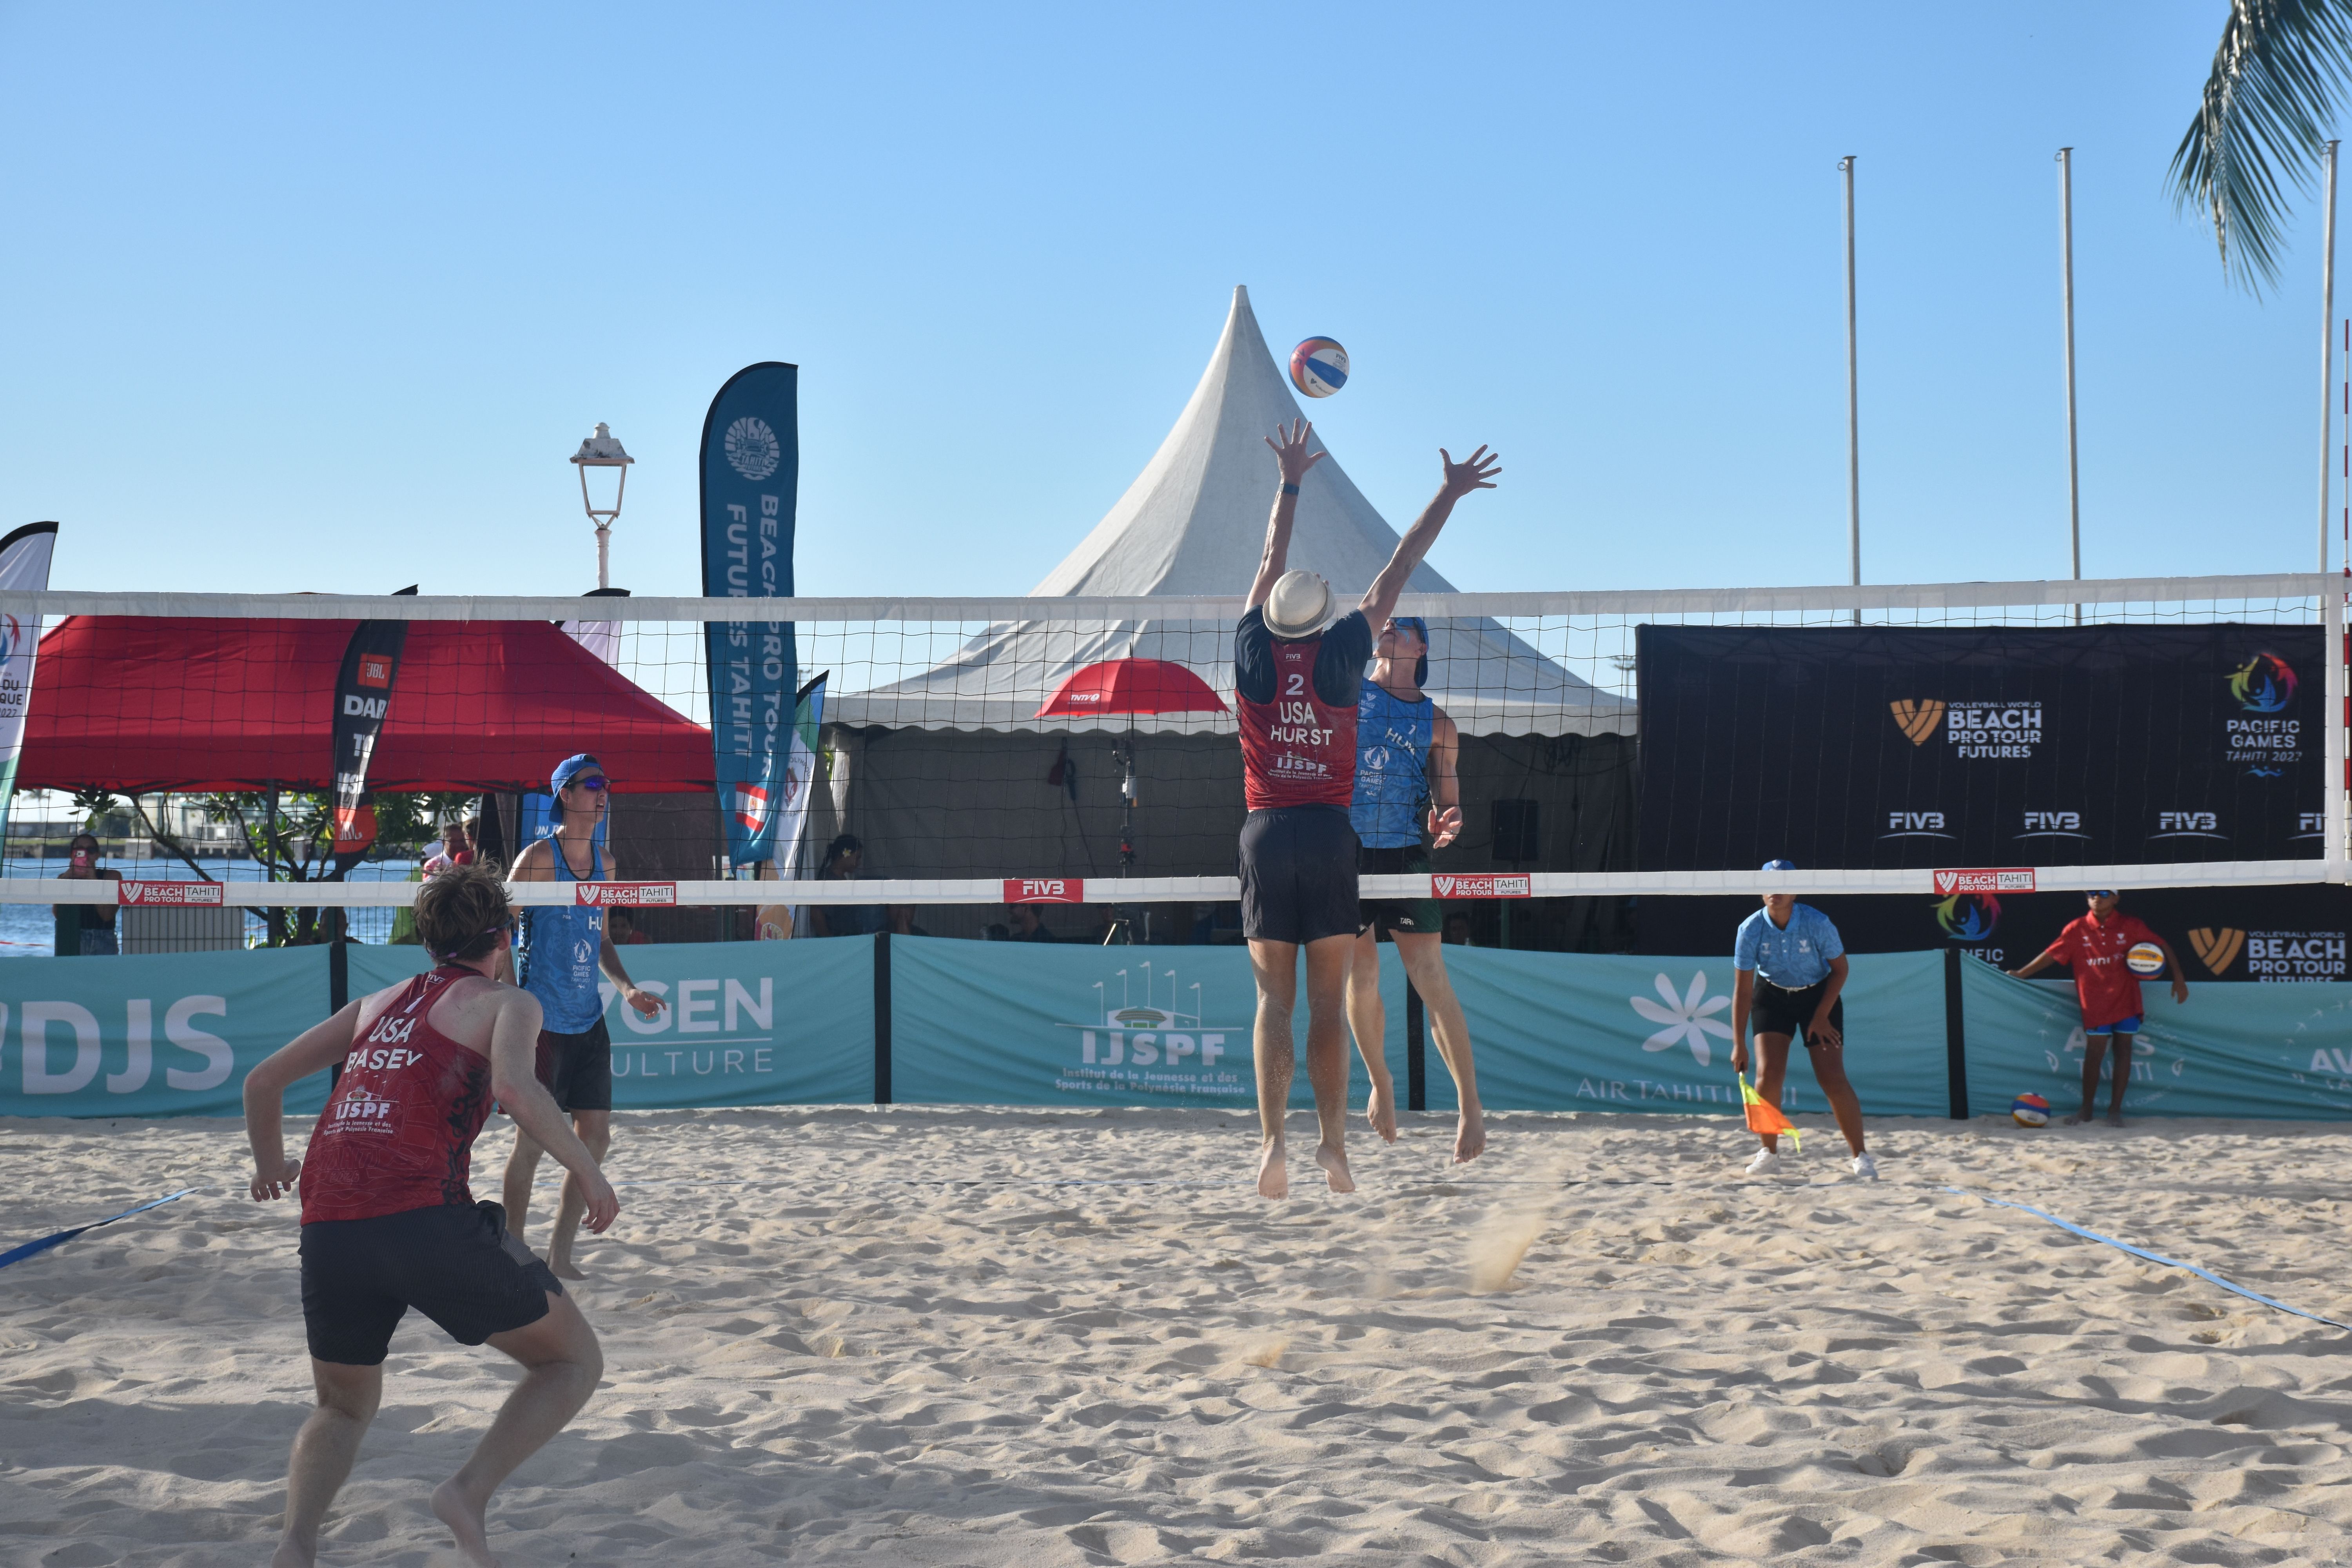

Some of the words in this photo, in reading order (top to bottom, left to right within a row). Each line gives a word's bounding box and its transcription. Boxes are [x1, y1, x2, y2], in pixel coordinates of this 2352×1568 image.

[760, 494, 779, 597] BEACH
[367, 662, 385, 679] JBL
[3, 679, 19, 691] DU
[1286, 674, 1304, 695] 2
[0, 708, 17, 717] 027
[344, 695, 390, 719] DAR
[731, 657, 752, 757] TAHITI
[1280, 702, 1316, 724] USA
[1948, 709, 2042, 729] BEACH
[2227, 720, 2300, 733] PACIFIC
[1270, 725, 1333, 745] HURST
[1948, 731, 1987, 744] PRO
[1990, 730, 2042, 744] TOUR
[2231, 735, 2296, 748] GAMES
[1958, 746, 2031, 758] FUTURES
[2226, 751, 2266, 761] TAHITI
[1277, 757, 1327, 773] IJSPF
[1360, 770, 1387, 780] PACIFIC
[1361, 776, 1384, 785] GAMES
[1889, 812, 1944, 829] FIVB
[2025, 812, 2080, 829] FIVB
[2160, 812, 2217, 830] FIVB
[2299, 813, 2325, 830] FI
[1456, 881, 1492, 890] BEACH
[1495, 879, 1527, 888] TAHITI
[1958, 876, 1996, 885] BEACH
[1999, 874, 2031, 882] TAHITI
[144, 887, 183, 897] BEACH
[186, 887, 220, 896] TAHITI
[601, 889, 637, 898] BEACH
[640, 887, 673, 897] TAHITI
[1023, 881, 1064, 895] FIVB
[589, 916, 603, 931] HU
[2248, 939, 2346, 959] BEACH
[2249, 960, 2290, 974] PRO
[2292, 960, 2346, 975] TOUR
[368, 1016, 416, 1043] USA
[1083, 1030, 1225, 1066] IJSPF
[2064, 1026, 2155, 1056] AS
[611, 1048, 773, 1077] ULTURE
[1063, 1067, 1106, 1079] Institut
[1110, 1070, 1124, 1080] de
[1128, 1070, 1139, 1080] la
[1145, 1071, 1196, 1082] Jeunesse
[1201, 1073, 1213, 1082] et
[1218, 1073, 1238, 1082] des
[1055, 1079, 1092, 1090] Sports
[1098, 1080, 1110, 1090] de
[1114, 1080, 1125, 1090] la
[1191, 1083, 1245, 1094] Française
[1577, 1078, 1634, 1100] AIR
[1634, 1080, 1733, 1103] TAHITI
[336, 1102, 390, 1120] IJSPF
